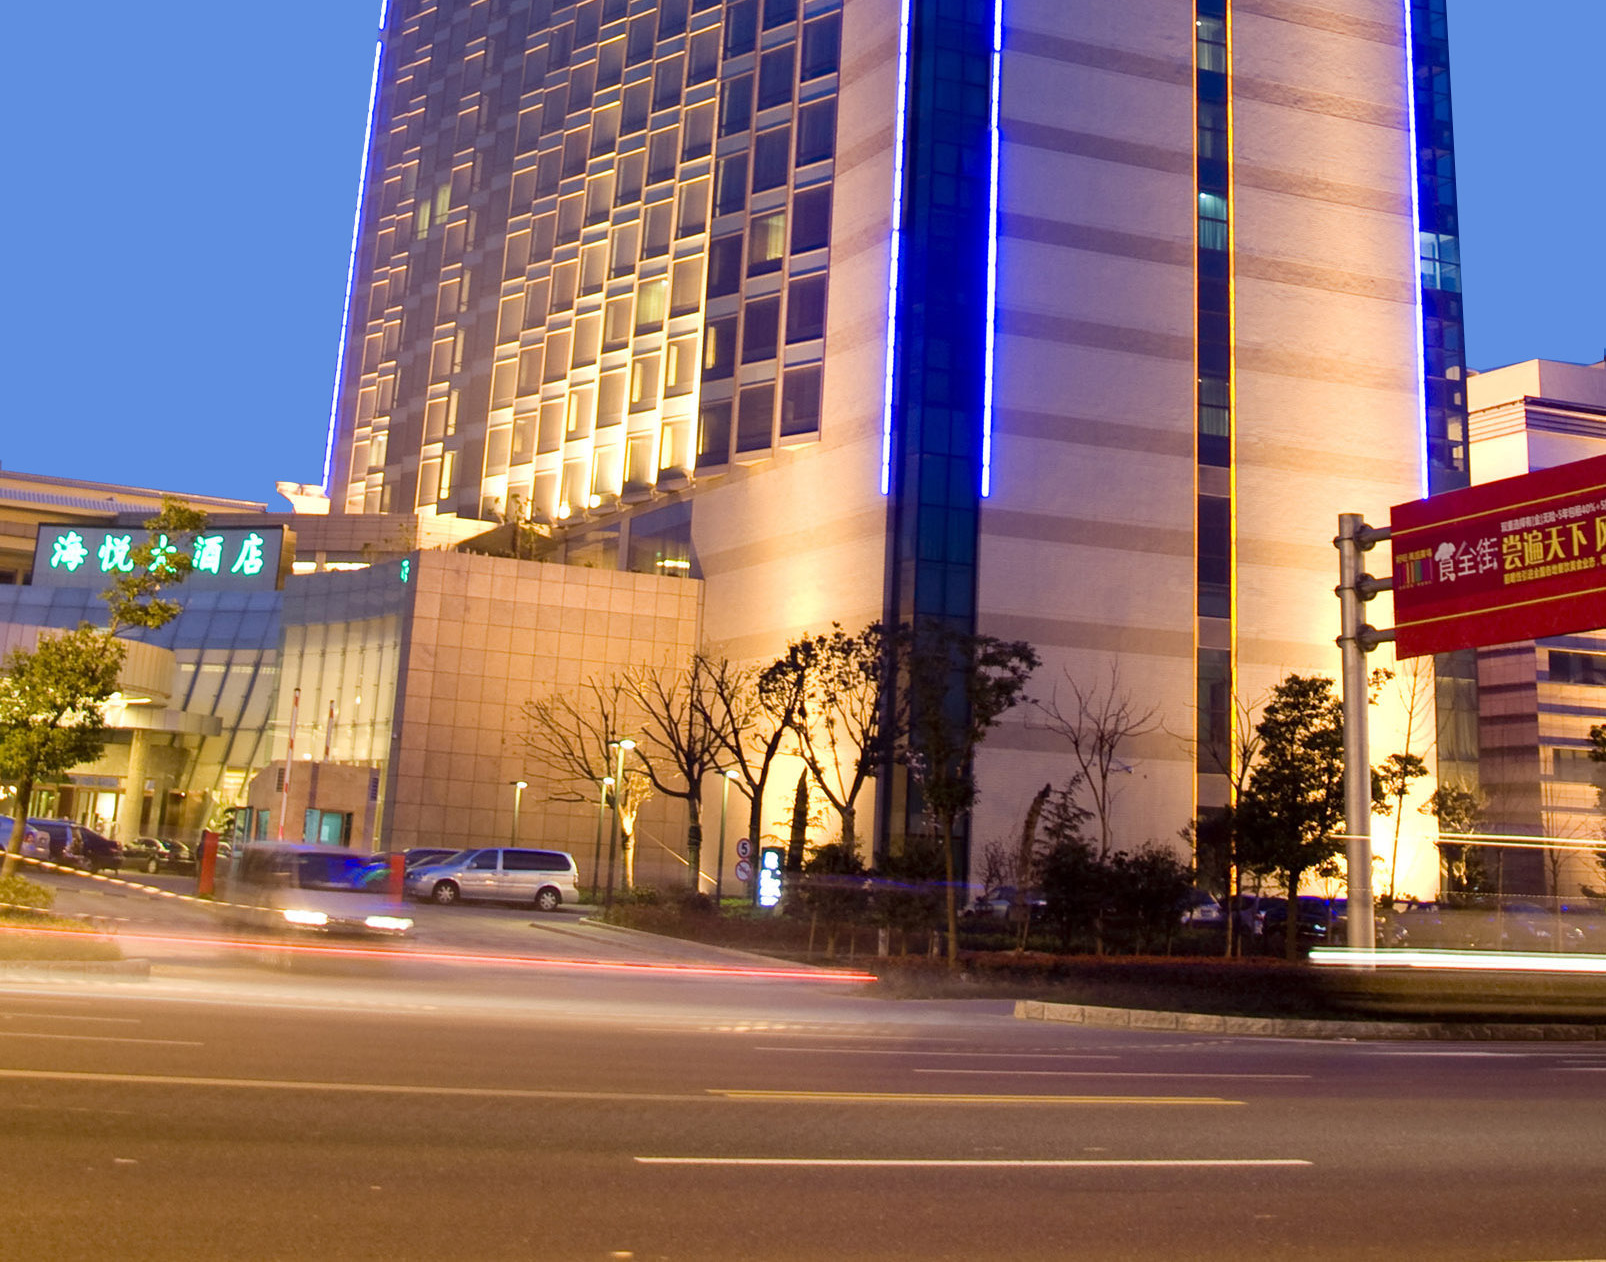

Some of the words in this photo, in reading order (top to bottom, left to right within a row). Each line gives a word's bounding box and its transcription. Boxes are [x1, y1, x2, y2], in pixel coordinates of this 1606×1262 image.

[50, 530, 264, 576] 海悦大酒店
[740, 842, 748, 855] 5
